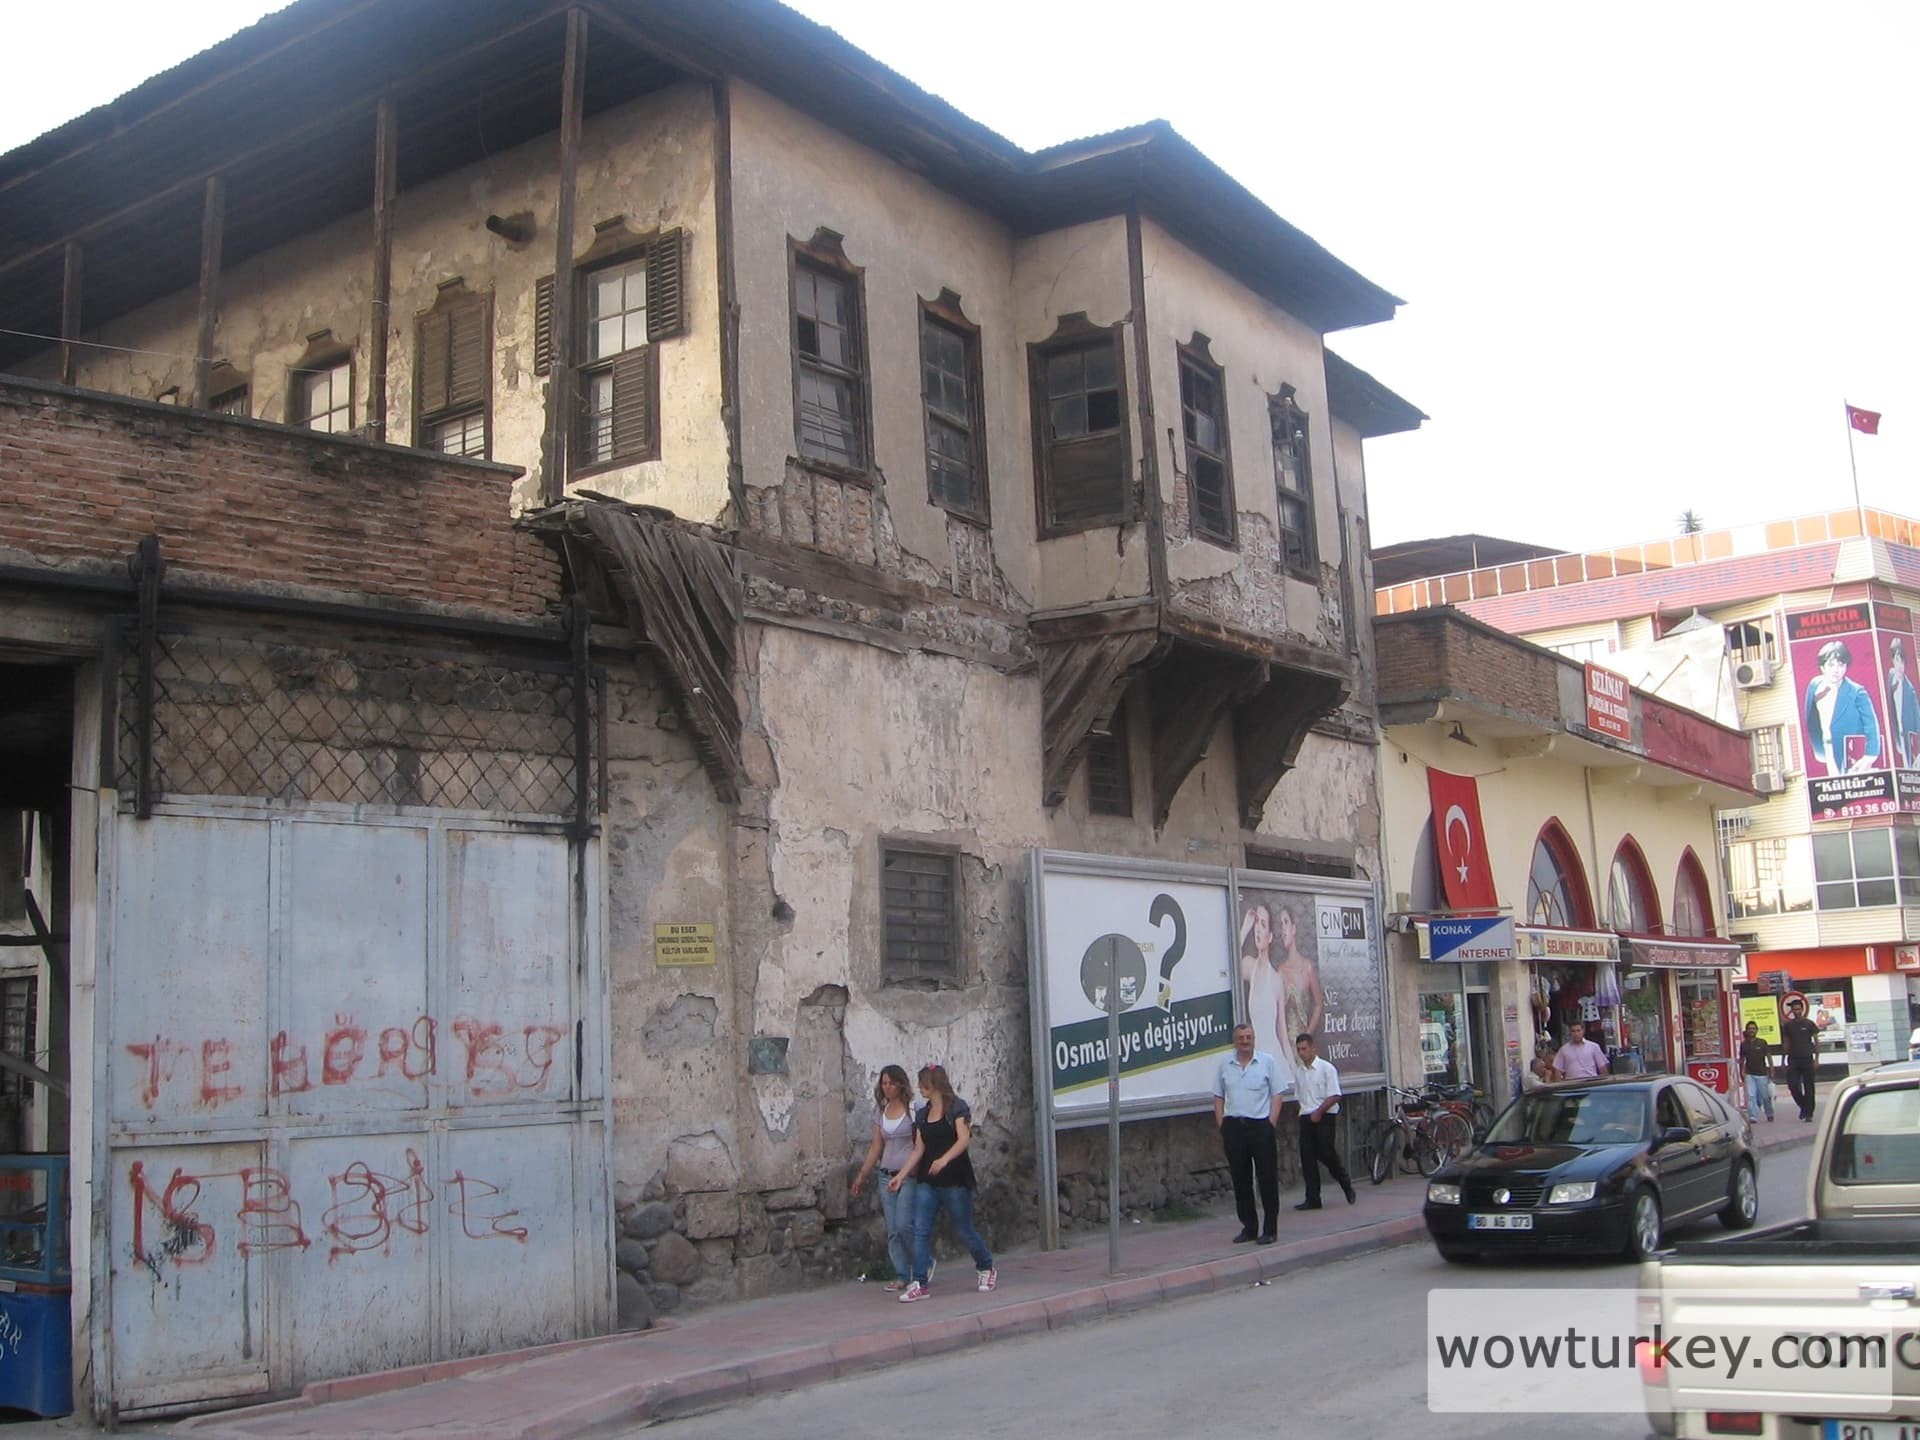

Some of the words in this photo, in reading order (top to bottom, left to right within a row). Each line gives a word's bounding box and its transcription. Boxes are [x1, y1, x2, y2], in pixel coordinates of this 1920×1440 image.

[1800, 608, 1859, 627] KÜLTÜR
[1817, 793, 1842, 802] Olan
[1844, 788, 1885, 799] Kazanır
[1841, 805, 1862, 817] 813
[1865, 803, 1879, 813] 36
[1881, 801, 1896, 811] 00
[1432, 925, 1473, 936] KONAK
[1324, 1012, 1347, 1033] Evet
[1144, 1012, 1227, 1052] değişiyor...
